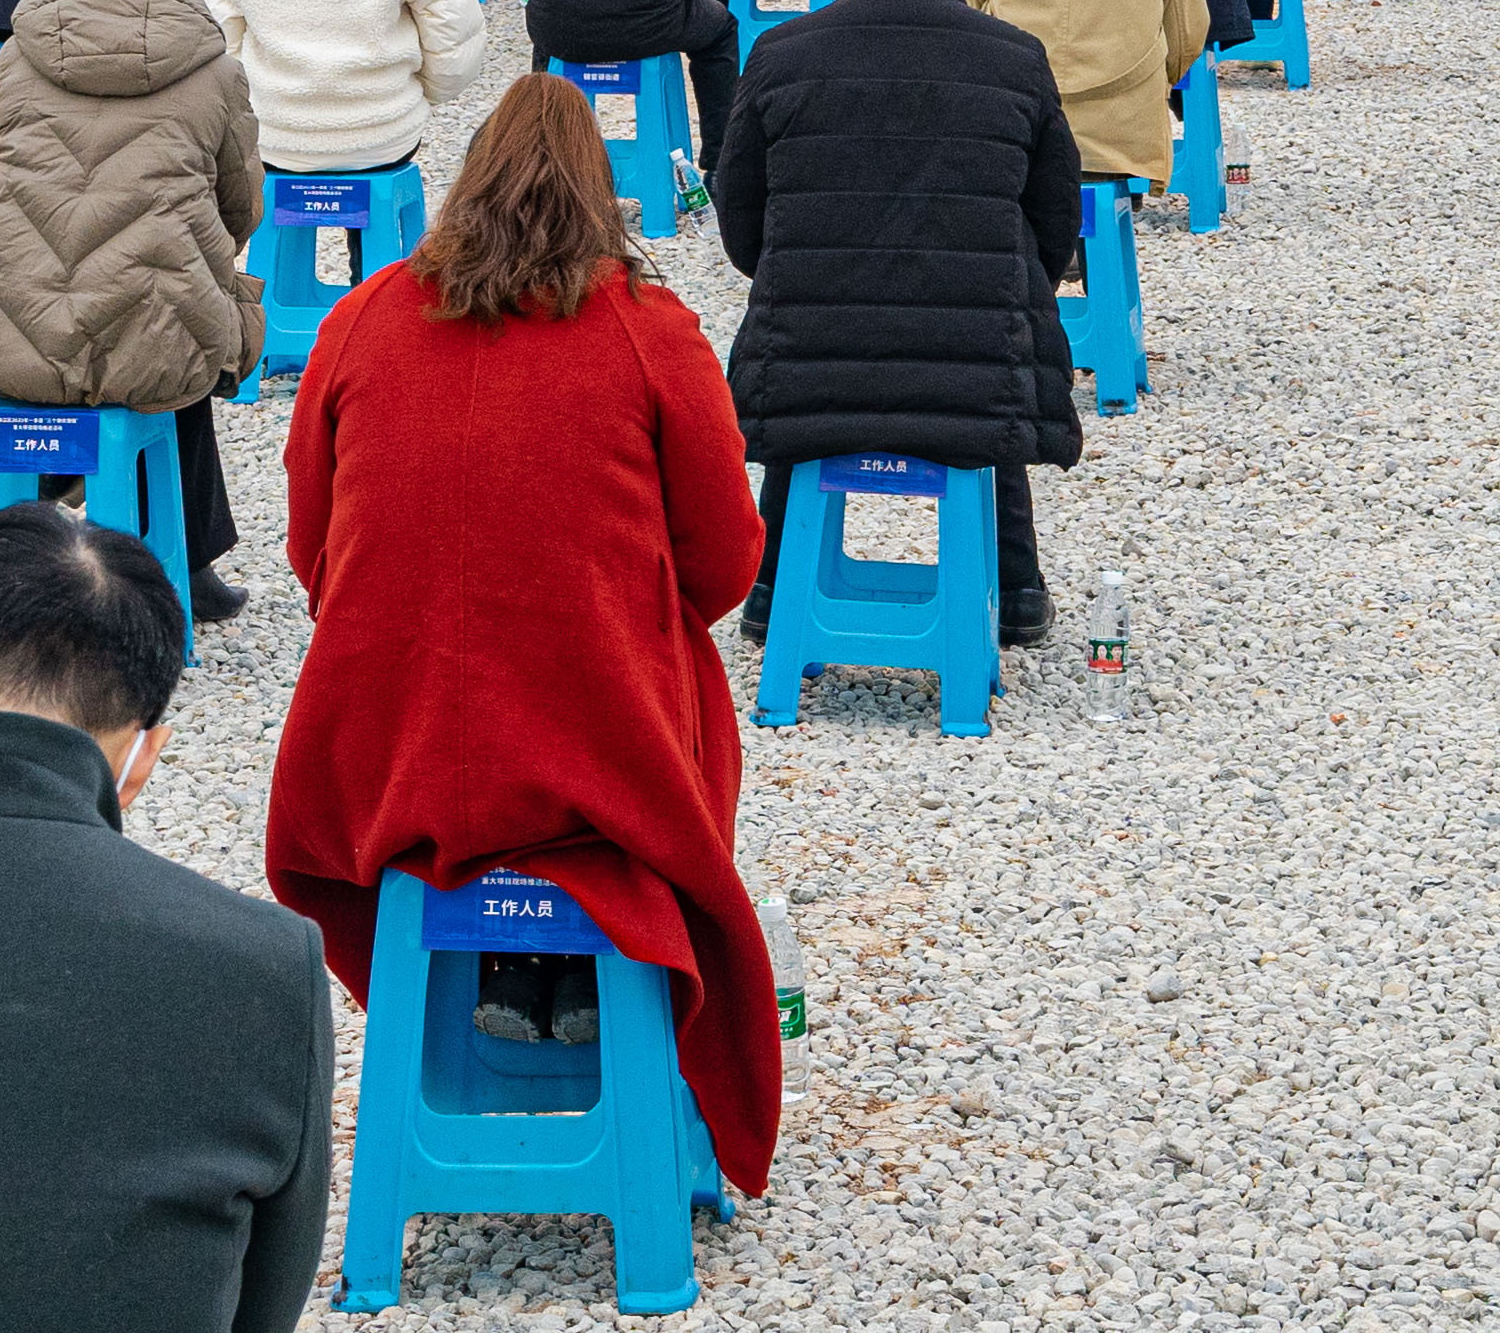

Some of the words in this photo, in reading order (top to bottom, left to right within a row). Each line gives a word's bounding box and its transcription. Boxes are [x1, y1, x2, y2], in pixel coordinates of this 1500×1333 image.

[305, 202, 339, 211] 工作人员
[14, 439, 59, 451] 工作人员
[860, 460, 906, 472] 工作人员
[483, 900, 552, 917] 工作人员
